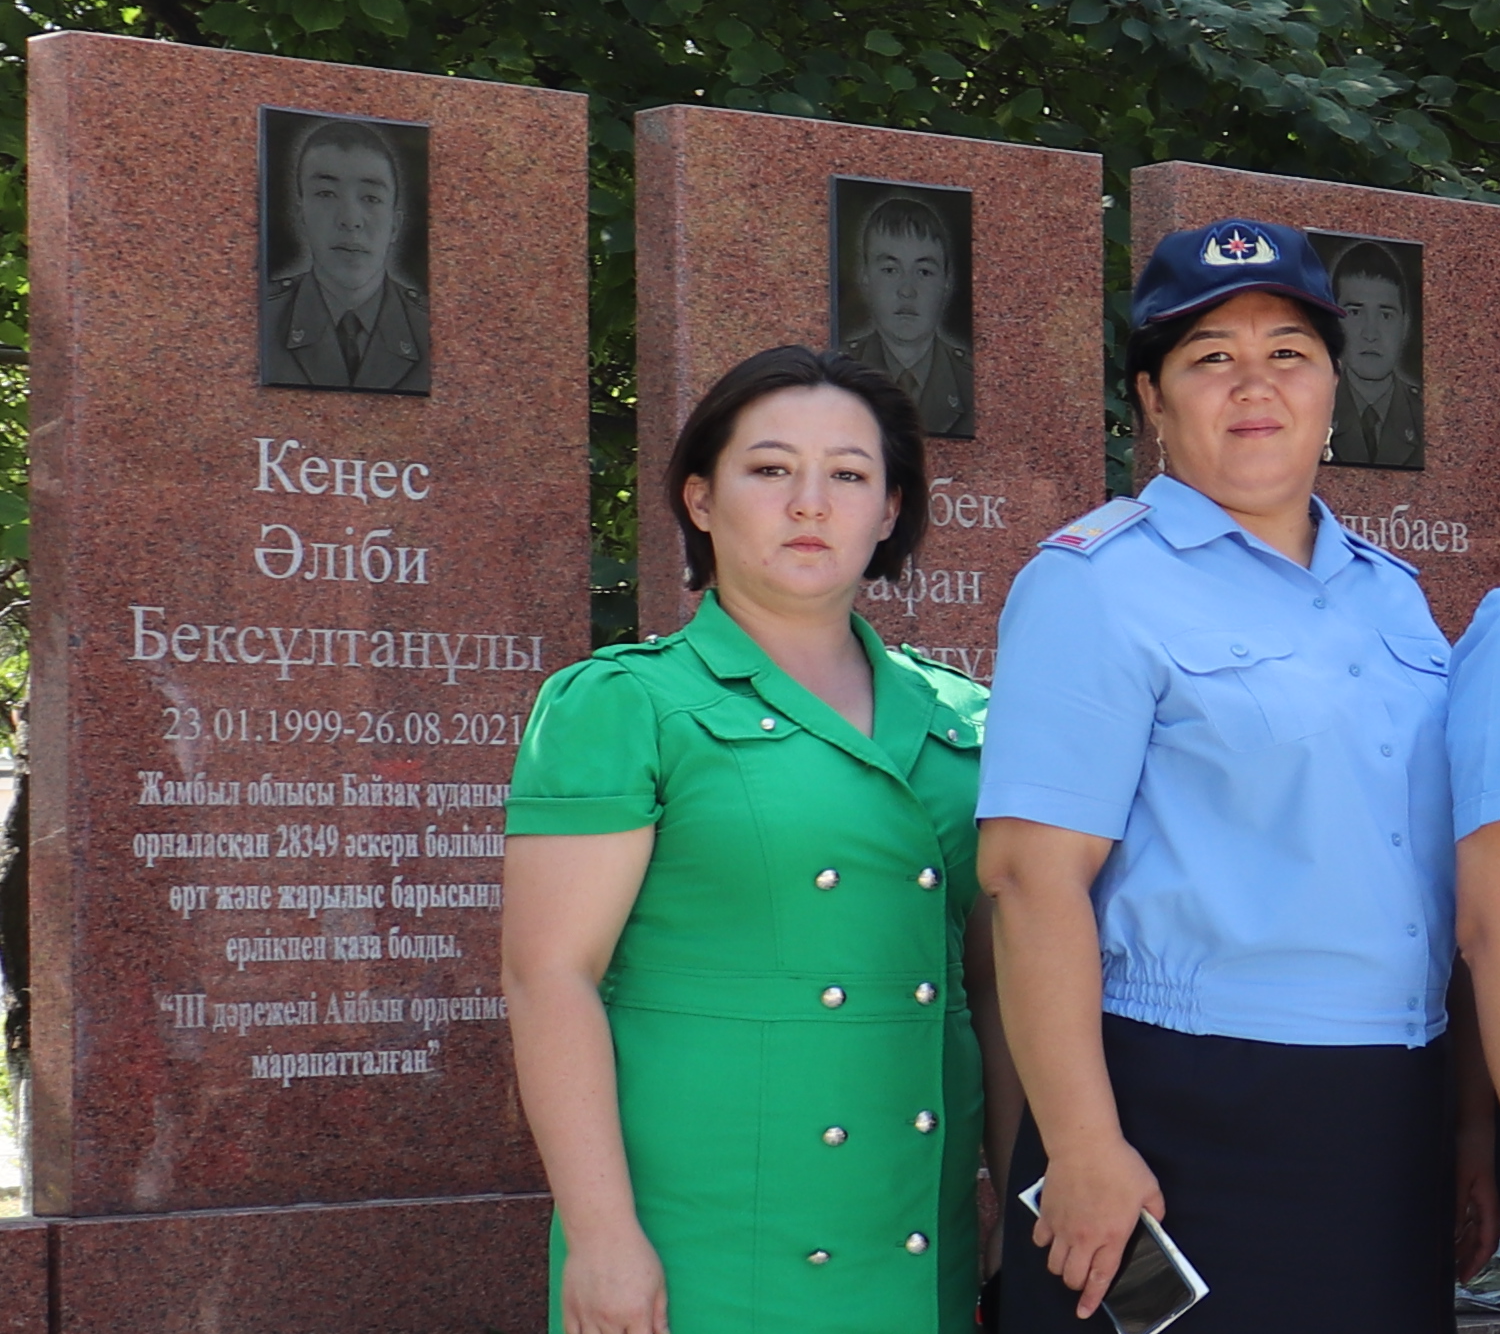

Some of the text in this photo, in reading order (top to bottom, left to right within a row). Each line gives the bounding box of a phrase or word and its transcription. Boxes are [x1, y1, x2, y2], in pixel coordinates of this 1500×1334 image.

[252, 437, 431, 505] Кеңес
[928, 476, 1007, 528] бек
[254, 523, 430, 585] Әліби
[128, 604, 544, 686] Бексұлтанұлы
[162, 706, 522, 746] 23.01.1999-26.08.2021
[137, 769, 244, 807] Жамбыл
[247, 772, 335, 808] облысы
[133, 829, 270, 868] орналасқан
[275, 824, 339, 859] 28349
[344, 832, 420, 867] әскери
[170, 875, 504, 919] өрт және жарылыс барысынд
[226, 926, 462, 971] ерлікпен қаза болды.
[213, 991, 319, 1036] дәрежелі
[323, 990, 405, 1025] Айбын
